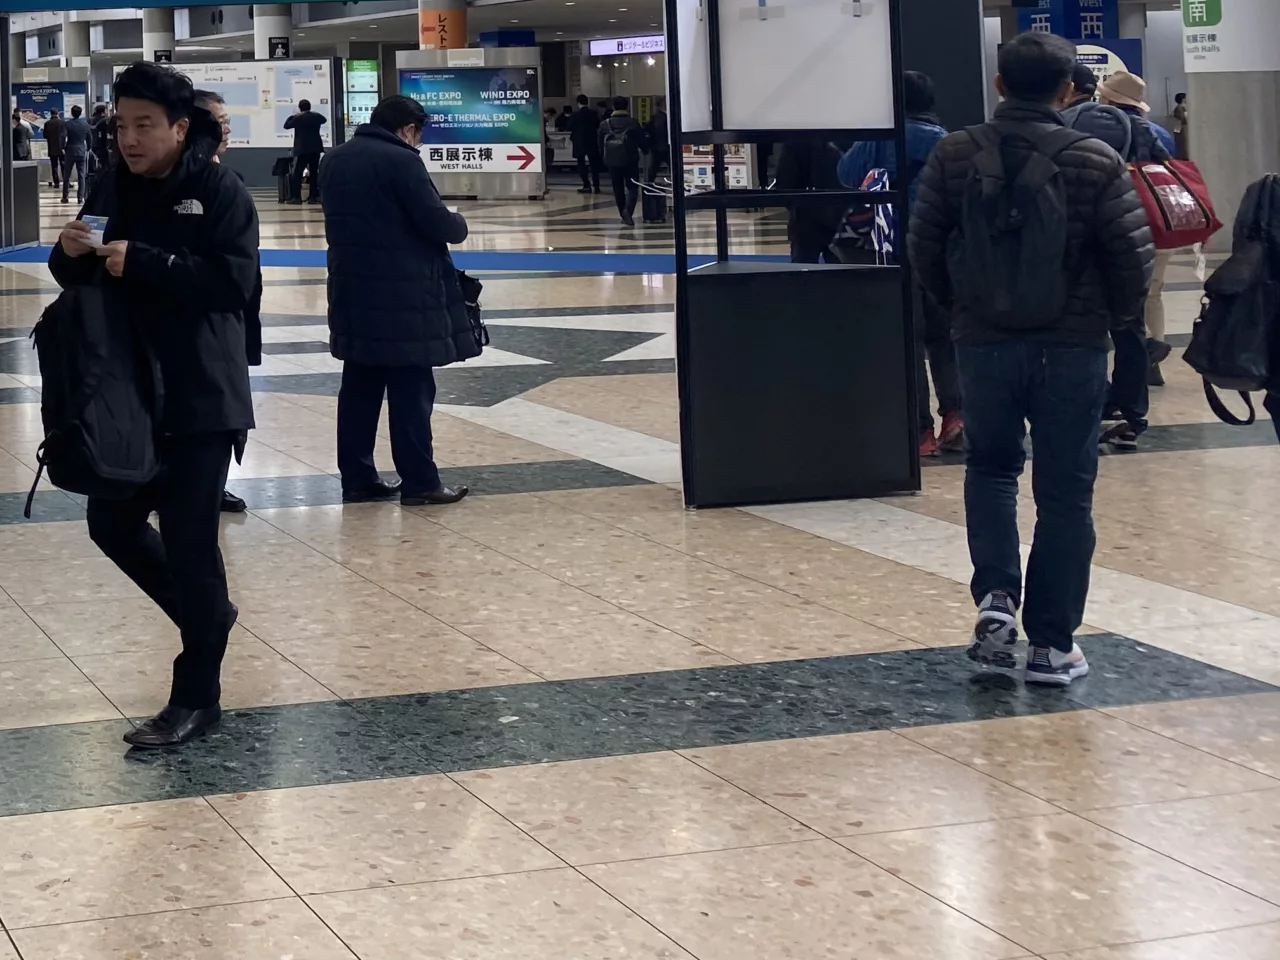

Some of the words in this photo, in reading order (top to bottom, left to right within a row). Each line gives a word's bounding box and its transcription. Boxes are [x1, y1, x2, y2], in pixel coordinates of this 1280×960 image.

[1080, 12, 1104, 39] 西
[438, 14, 448, 48] レスト
[1201, 45, 1221, 53] Halls
[427, 92, 438, 100] FC
[439, 91, 462, 100] EXPO
[480, 91, 505, 99] WIND
[506, 90, 530, 99] EXPO
[431, 113, 453, 122] ERO-E
[455, 113, 492, 121] THERMAL
[493, 112, 516, 121] EXPO
[429, 147, 494, 162] 西展示棟
